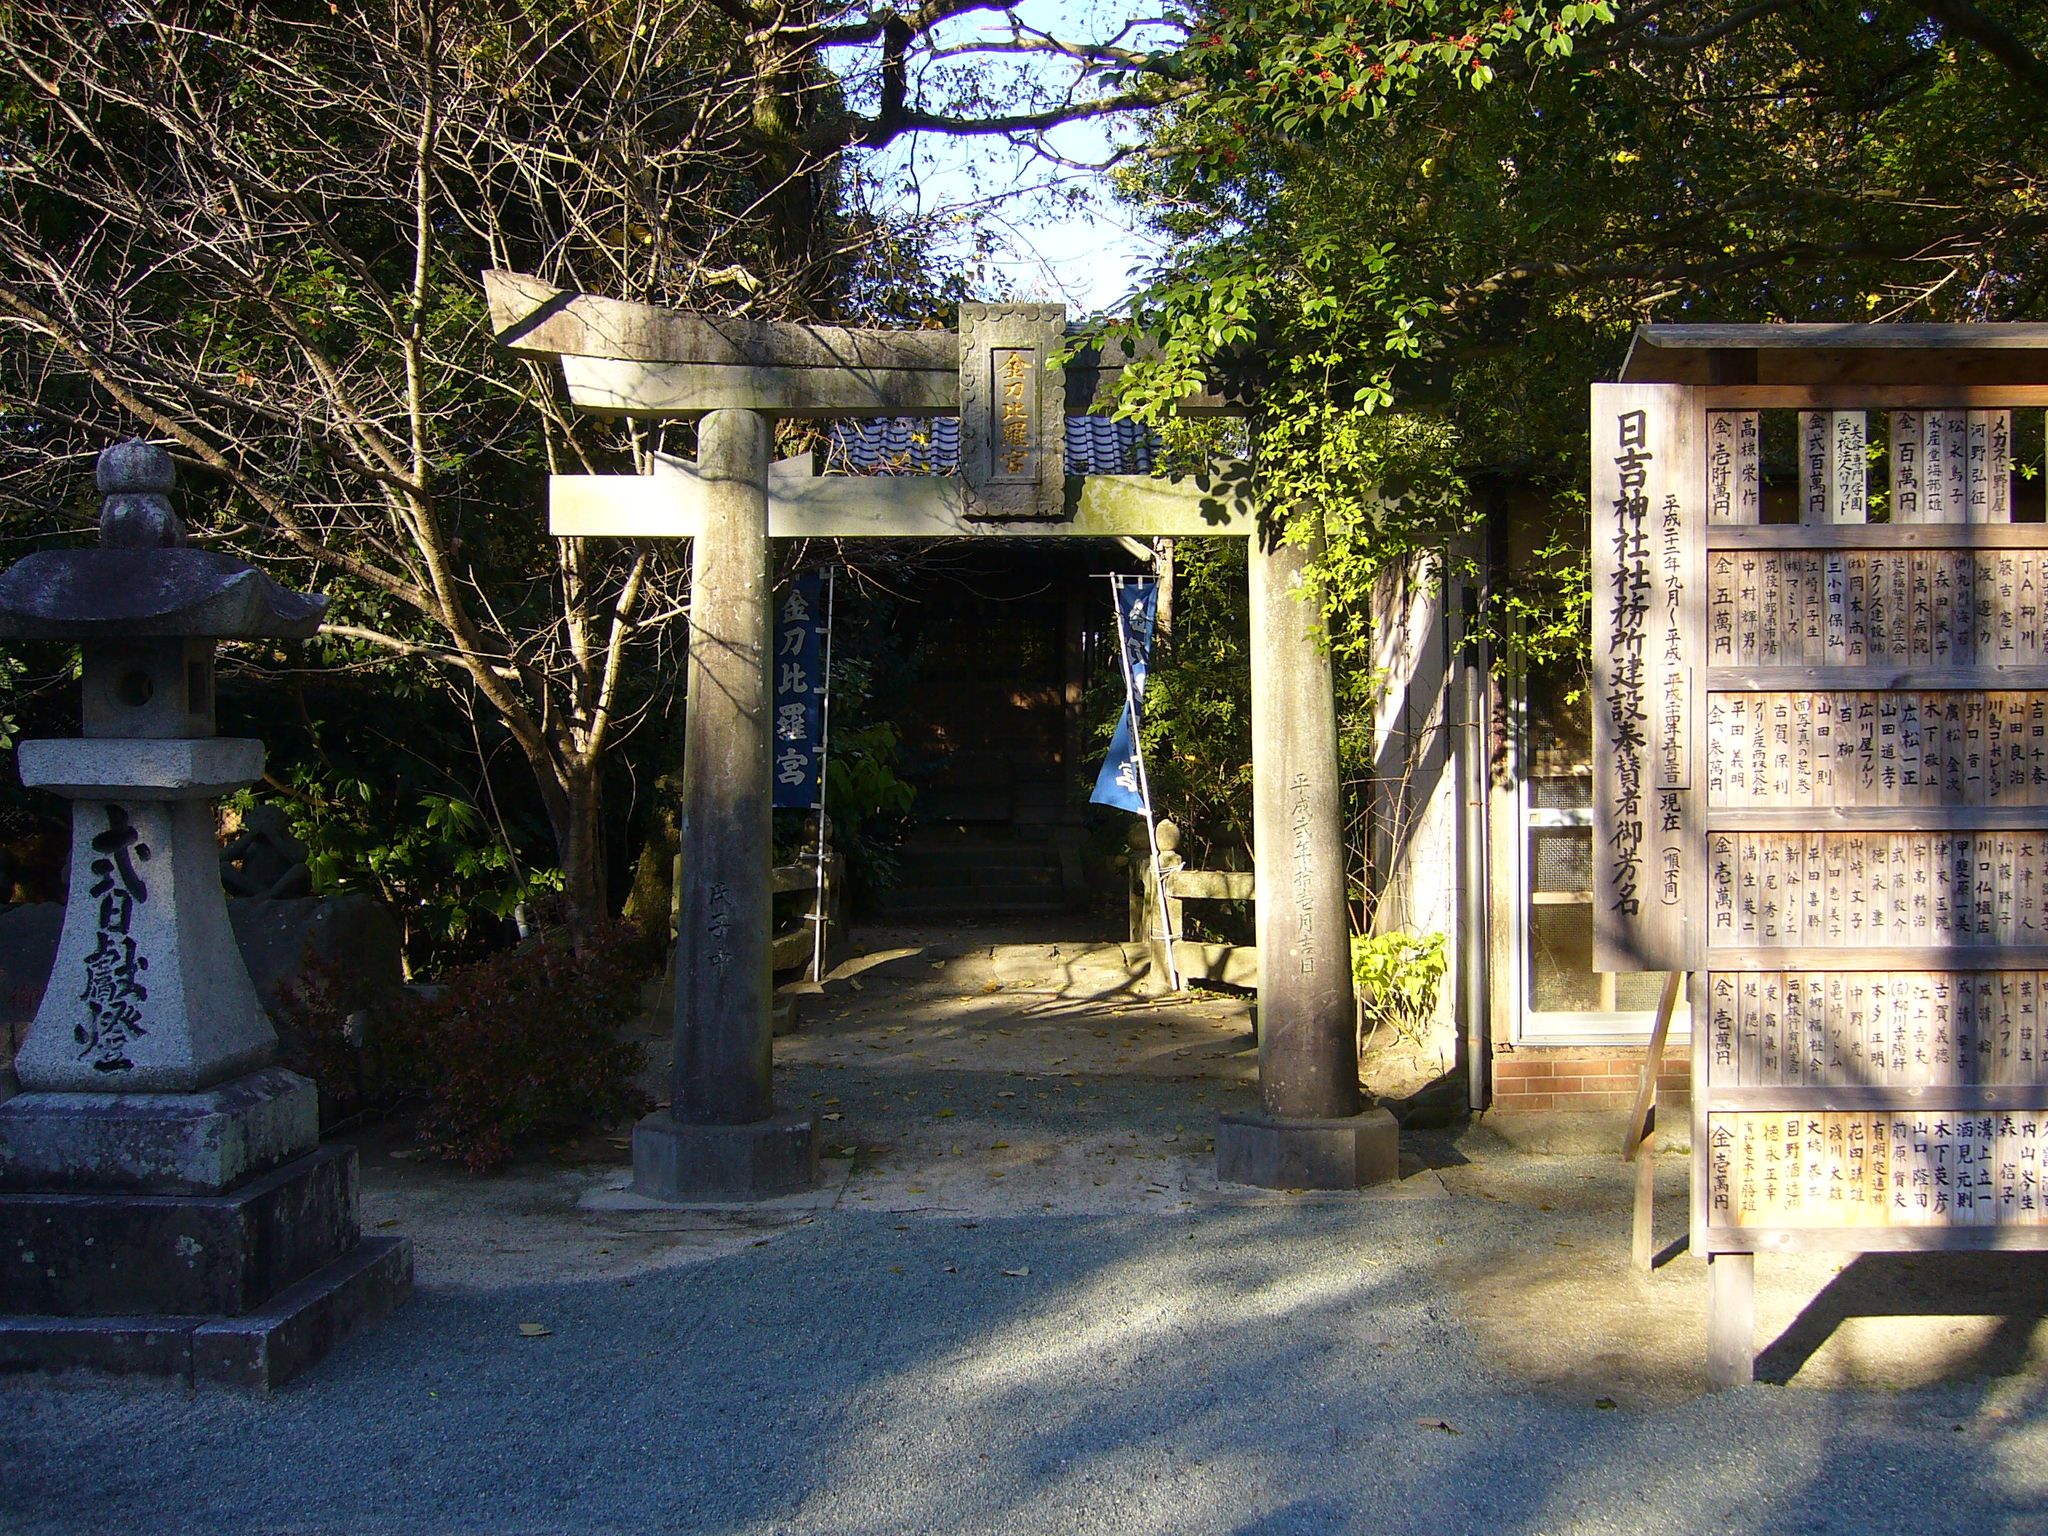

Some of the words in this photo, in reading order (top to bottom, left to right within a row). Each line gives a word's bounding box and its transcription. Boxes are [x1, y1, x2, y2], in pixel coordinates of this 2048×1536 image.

[997, 351, 1032, 475] 金刀比羅宮
[777, 588, 811, 787] 金刀比羅宮
